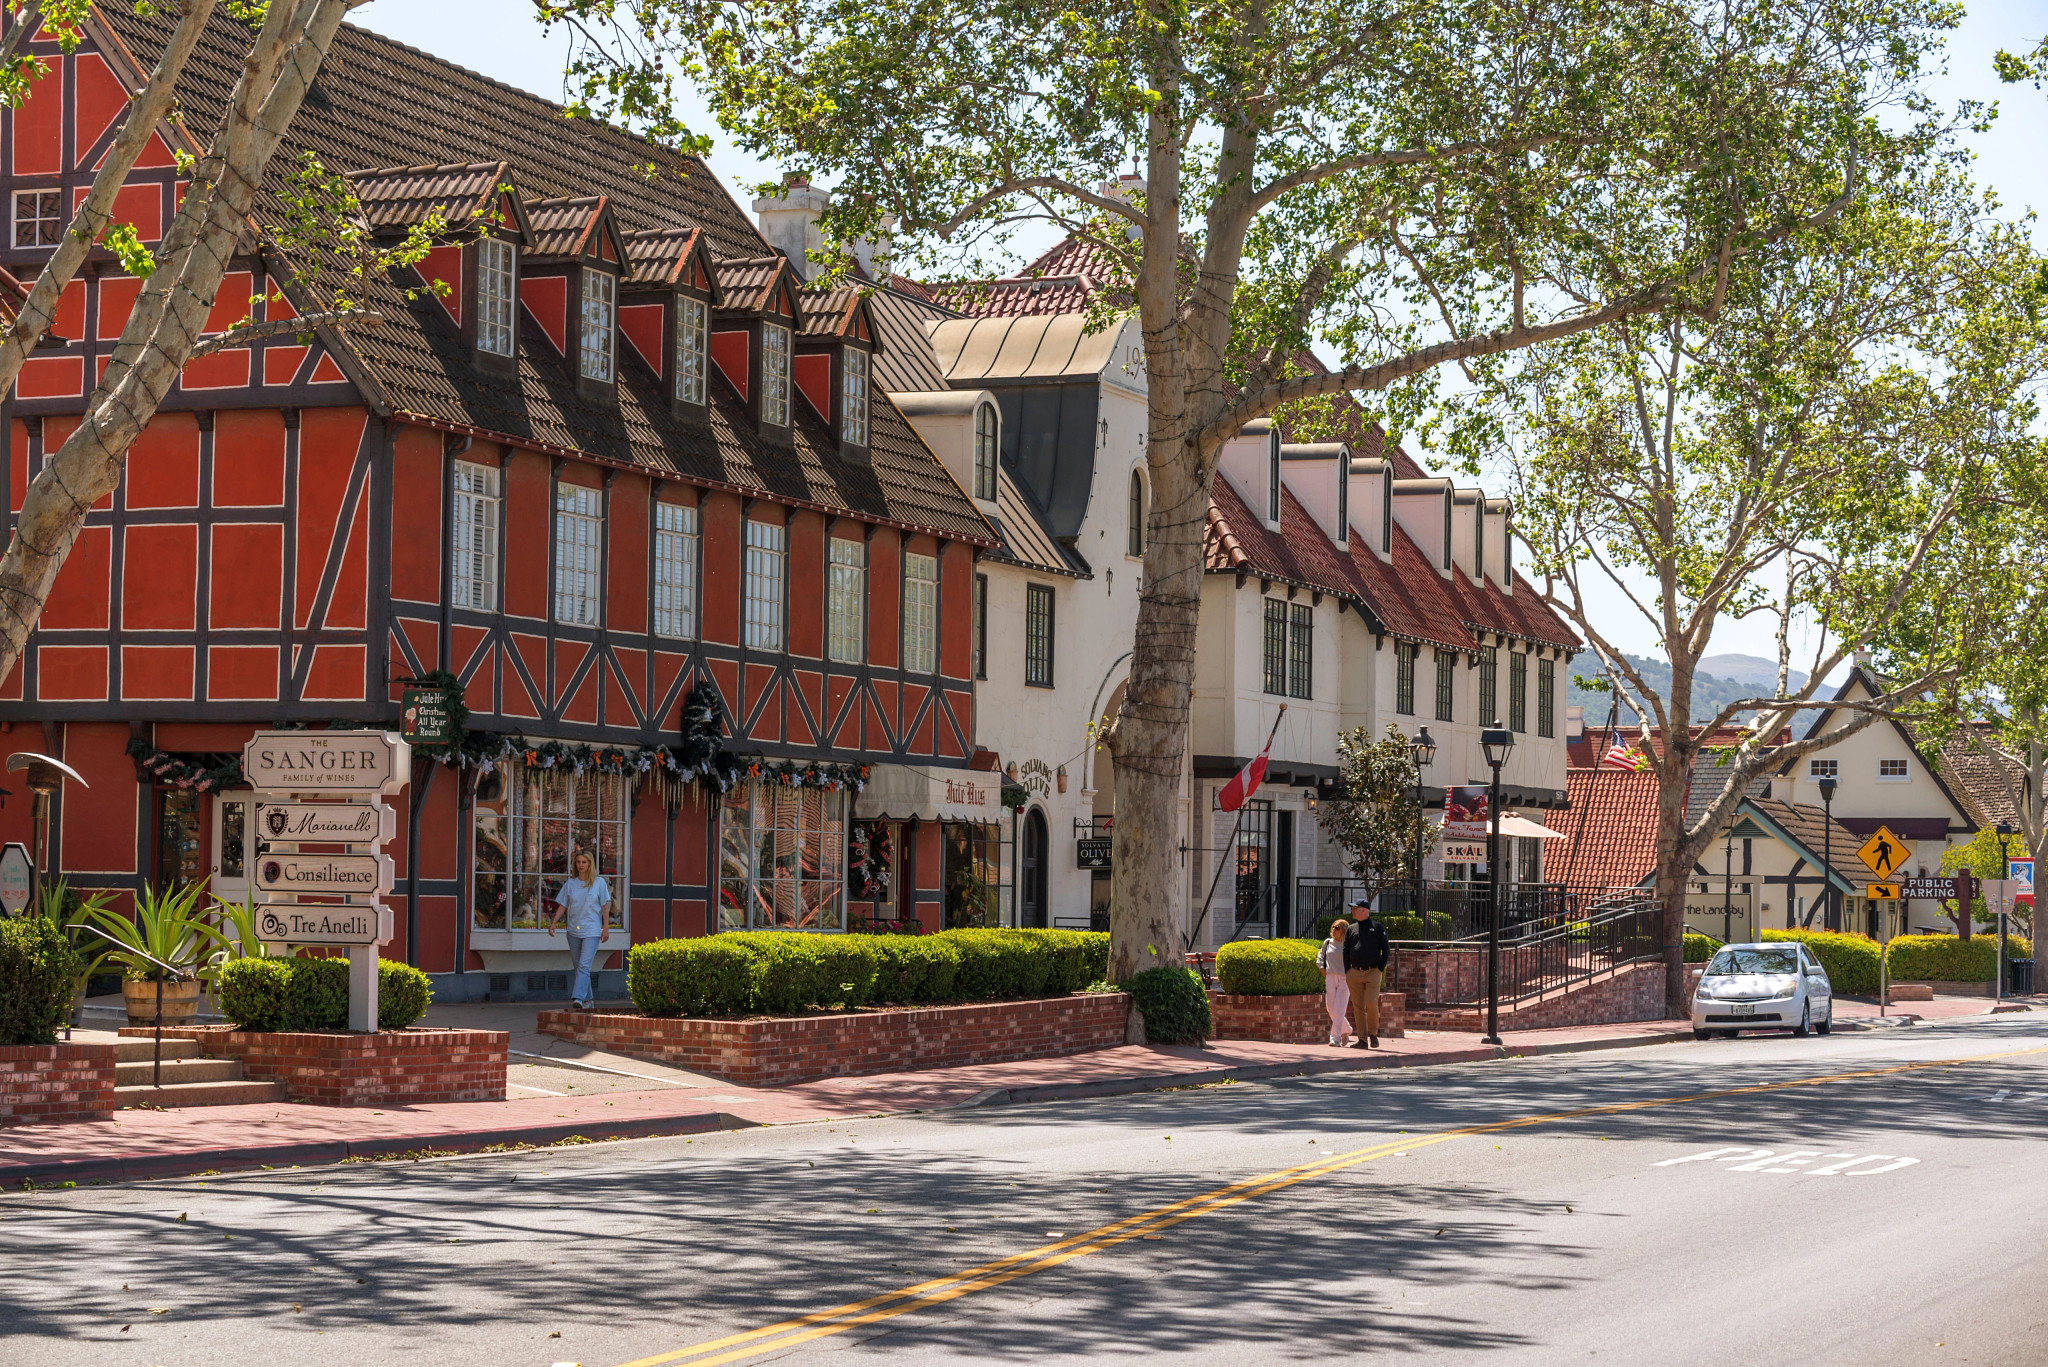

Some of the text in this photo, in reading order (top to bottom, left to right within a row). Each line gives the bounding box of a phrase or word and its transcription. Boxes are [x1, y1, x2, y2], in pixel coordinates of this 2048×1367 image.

[417, 716, 447, 728] All Year
[419, 727, 441, 737] Round
[310, 739, 329, 748] THE
[260, 750, 377, 769] SANGER
[282, 773, 355, 783] FAMILY of WINES
[1020, 759, 1053, 783] SOLVANG
[1023, 776, 1051, 799] OLIVE
[287, 811, 371, 835] Marianello
[1080, 849, 1112, 858] OLIVE
[284, 863, 373, 883] Consilience
[1909, 879, 1953, 888] PUBLIC
[1902, 888, 1955, 897] PARKING
[1687, 904, 1744, 918] the Landby
[289, 914, 368, 934] Tre Anelli
[1650, 1147, 1921, 1176] PED
